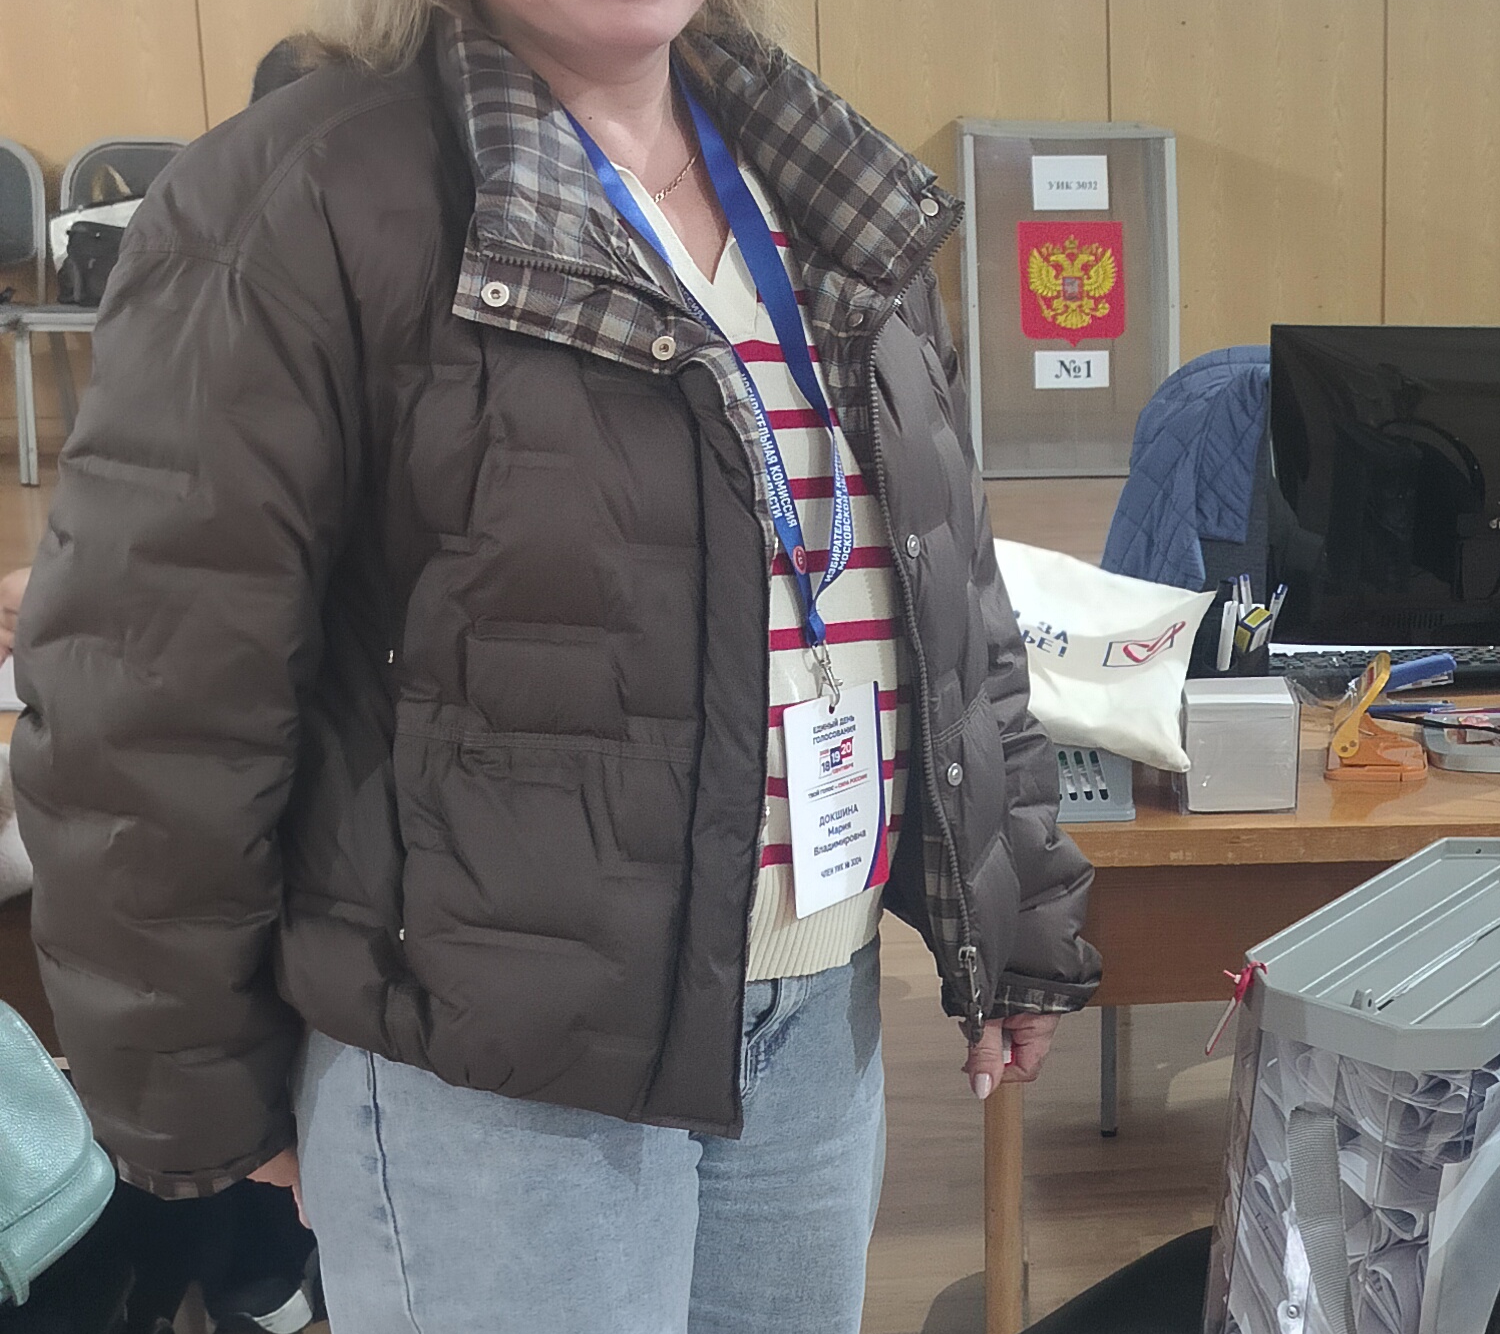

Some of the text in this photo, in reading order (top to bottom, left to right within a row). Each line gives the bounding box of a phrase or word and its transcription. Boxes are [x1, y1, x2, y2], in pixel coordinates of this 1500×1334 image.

[769, 465, 797, 528] КОМИССИЯ
[824, 489, 843, 583] ИЗБИРАТЕЛЬНАЯ
[812, 724, 856, 745] ГОЛОСОВАНИЯ
[831, 750, 840, 764] 19
[841, 741, 852, 755] 20
[819, 803, 859, 828] ДОКШИНА
[827, 821, 852, 837] Мария
[813, 829, 867, 857] Владимировна
